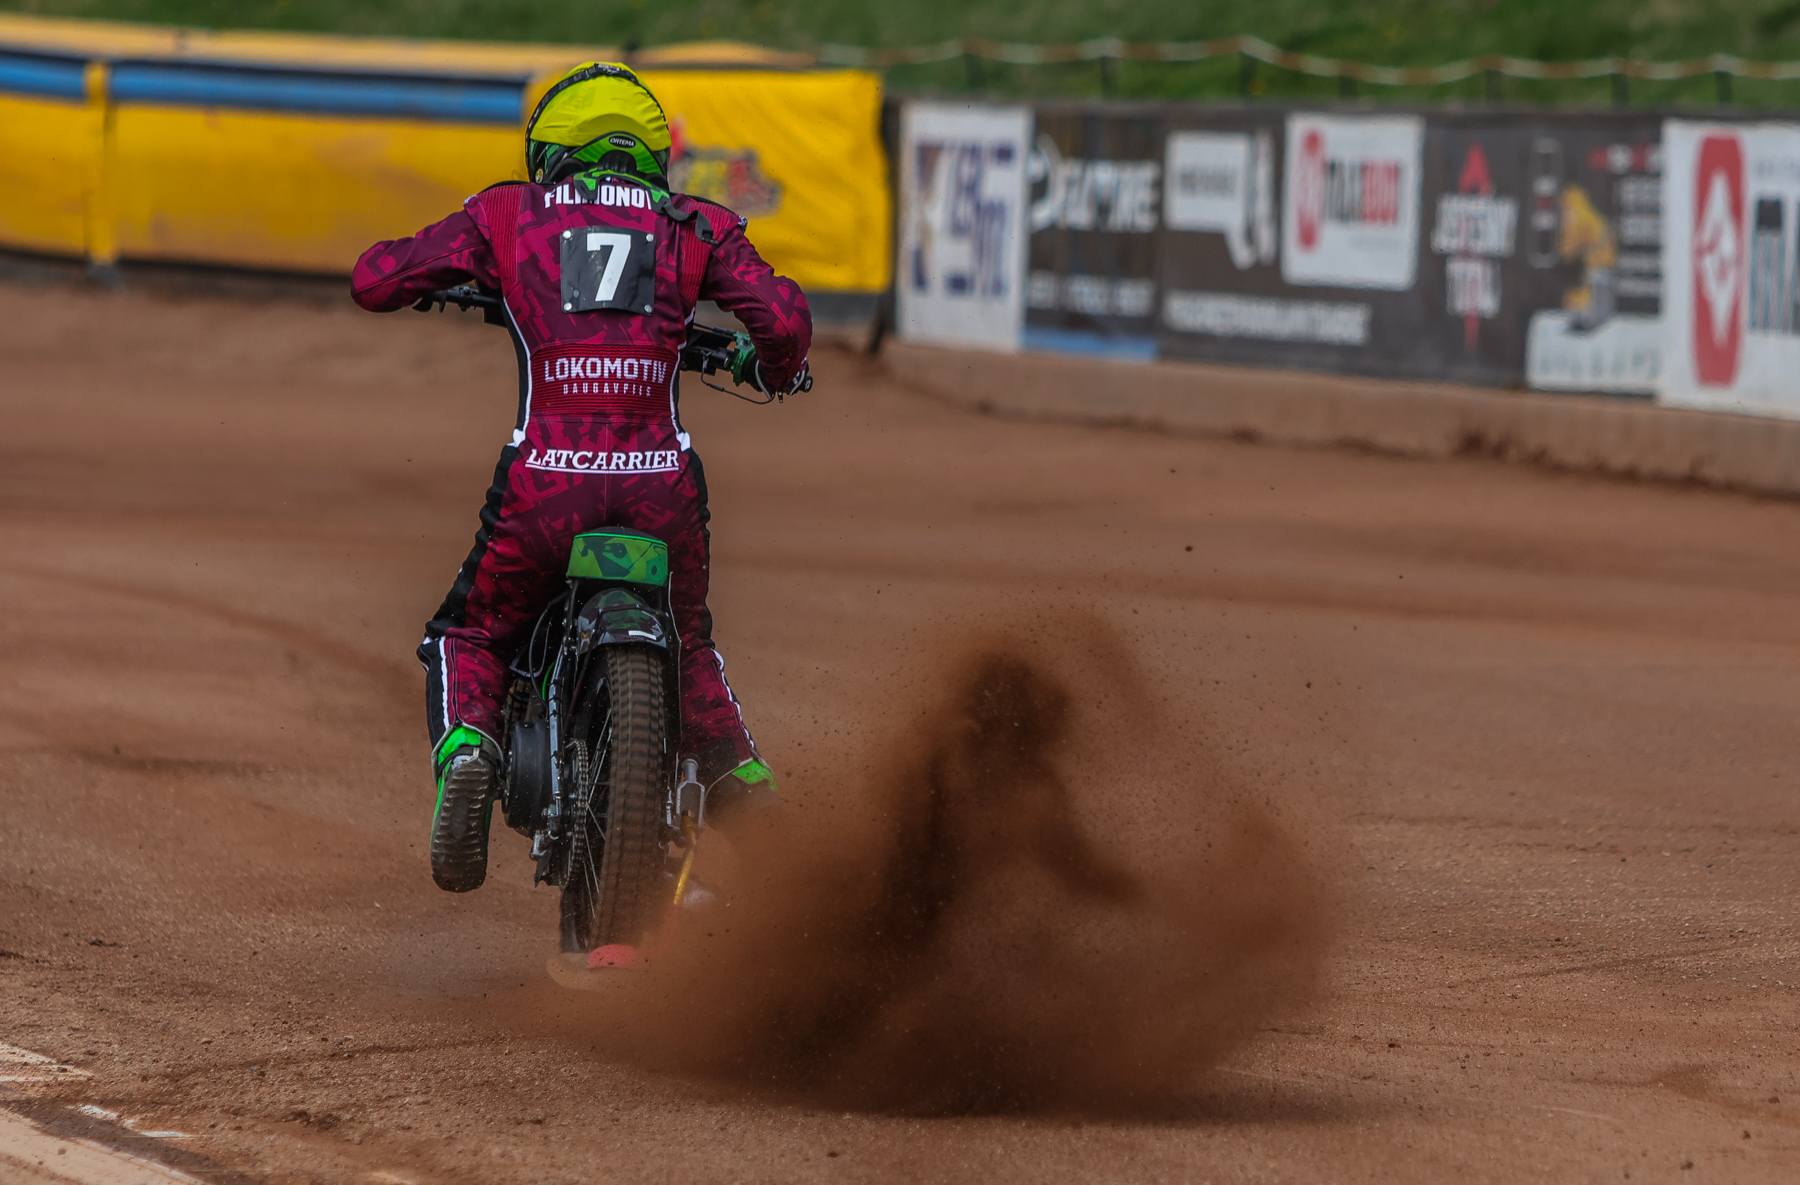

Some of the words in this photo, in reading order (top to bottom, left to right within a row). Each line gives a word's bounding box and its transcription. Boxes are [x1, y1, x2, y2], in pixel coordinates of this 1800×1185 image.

[610, 138, 635, 146] ORTEMA
[587, 233, 631, 302] 7
[544, 357, 667, 384] LOKOMOTIV
[563, 382, 651, 397] DAUGAVPILS
[525, 449, 680, 471] LATCARRIER
